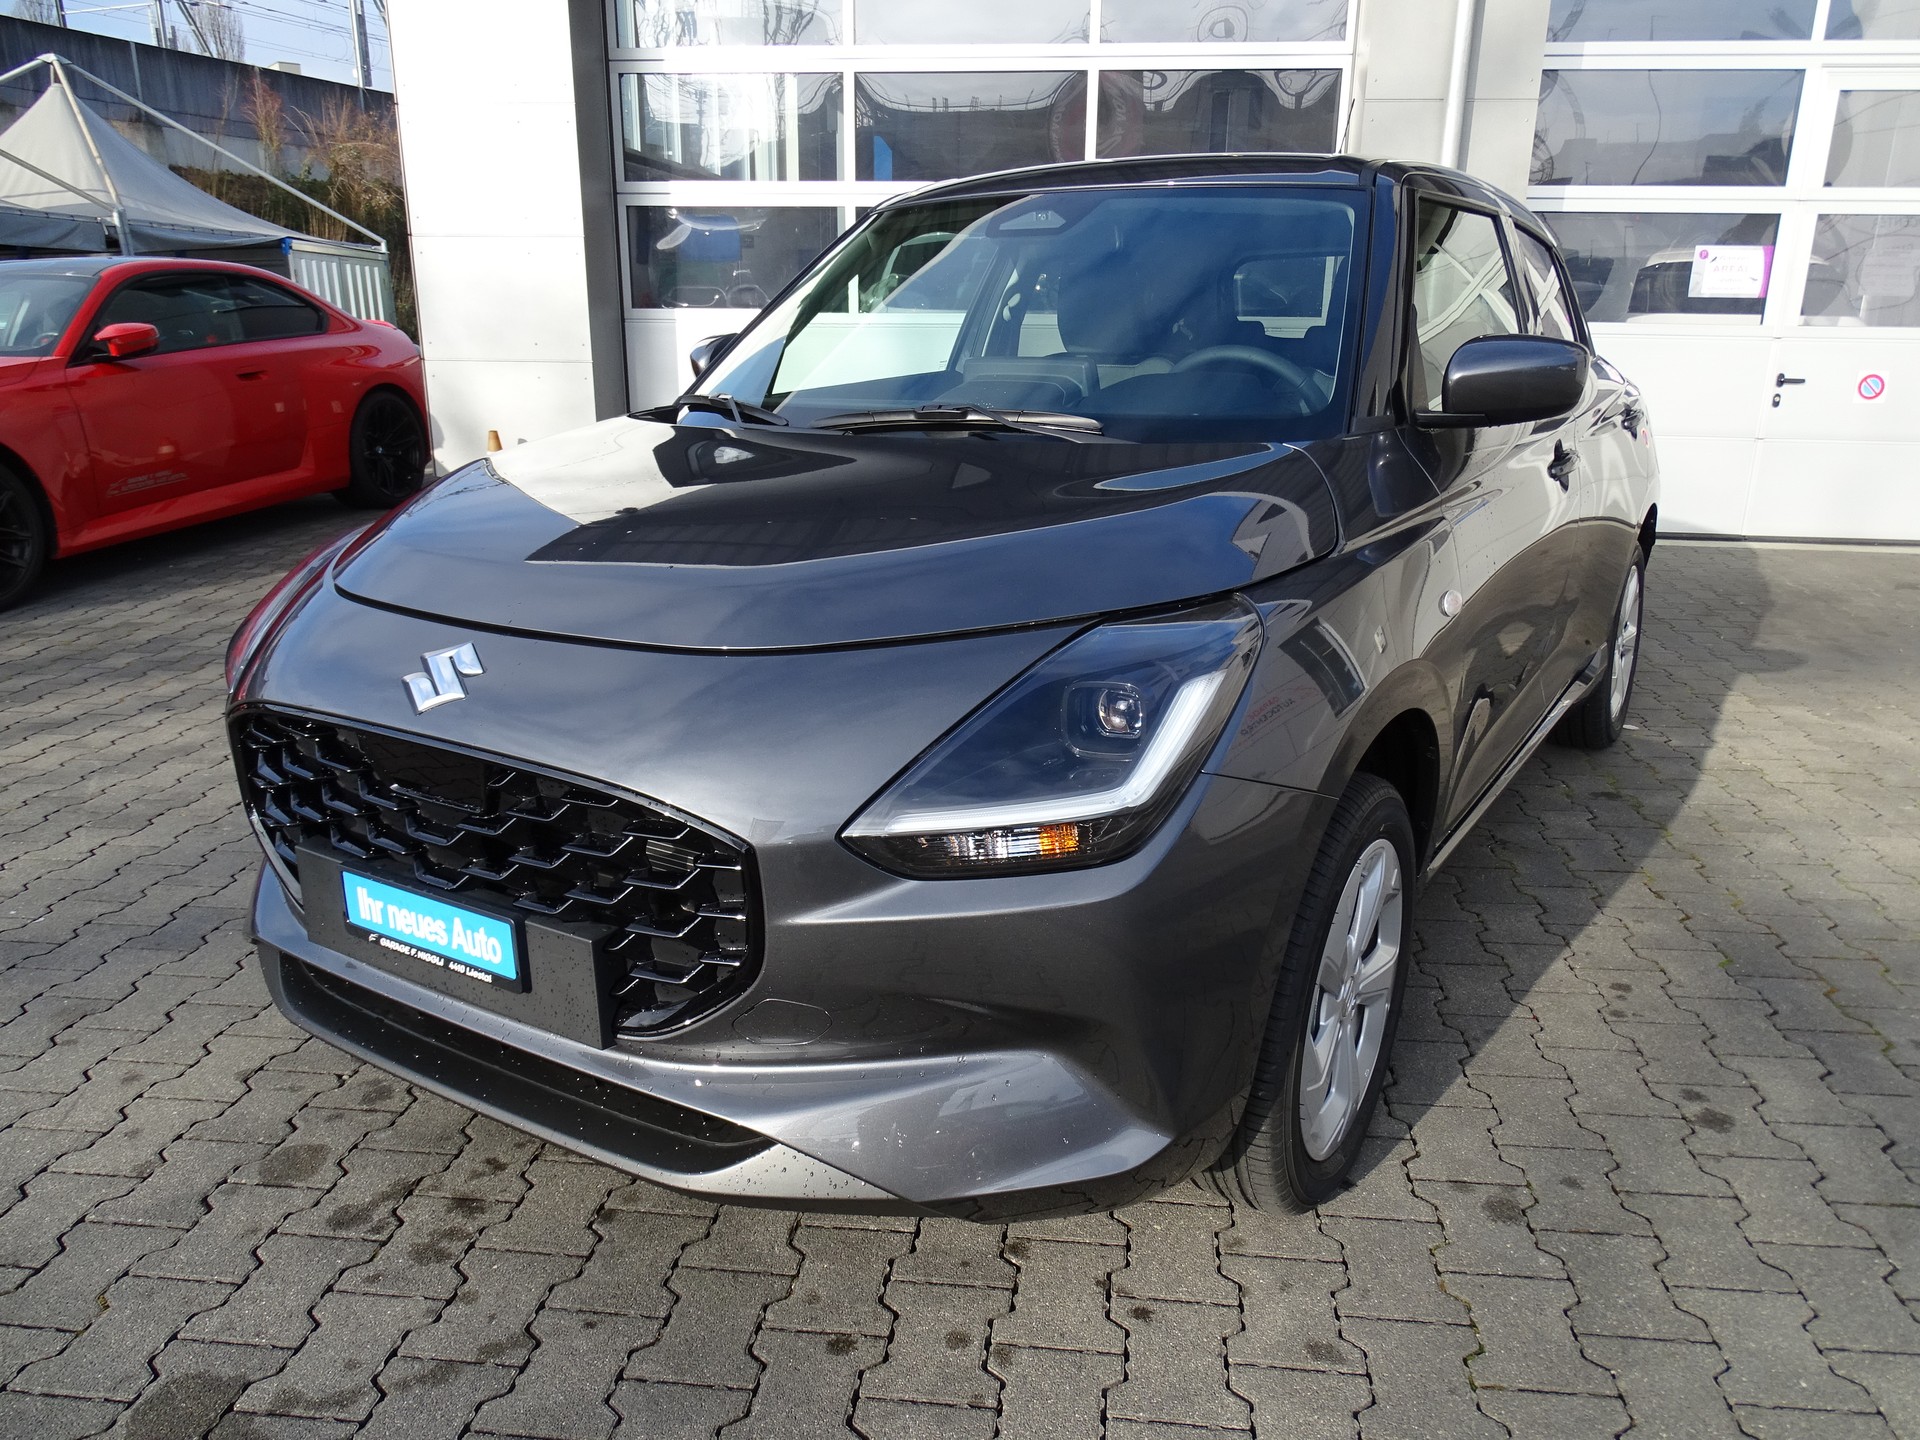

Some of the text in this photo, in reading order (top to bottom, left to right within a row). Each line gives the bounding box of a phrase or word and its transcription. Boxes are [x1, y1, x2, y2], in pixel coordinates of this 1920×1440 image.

[356, 886, 503, 964] Ihr neues Auto
[380, 938, 410, 954] GARAGE
[448, 961, 466, 974] 4410
[466, 966, 493, 983] Liestal
